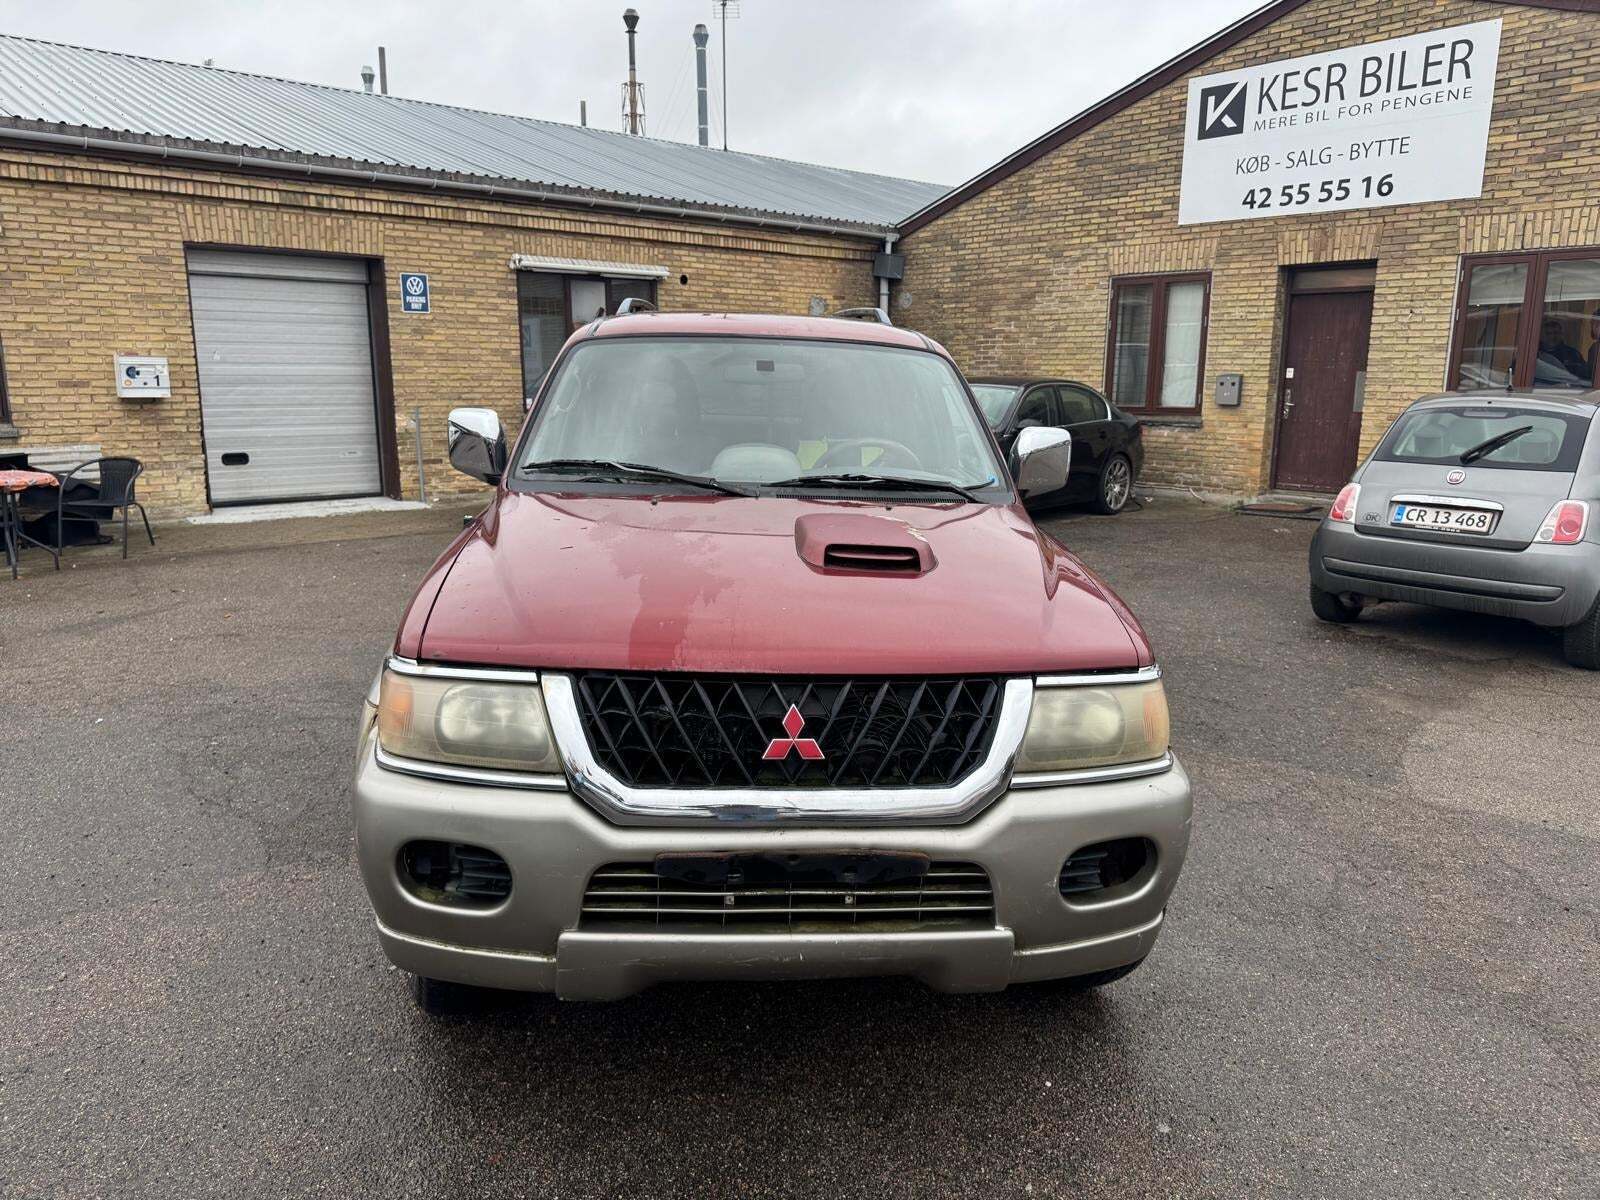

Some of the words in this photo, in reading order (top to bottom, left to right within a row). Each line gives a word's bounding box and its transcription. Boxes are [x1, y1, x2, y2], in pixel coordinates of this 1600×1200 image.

[1258, 63, 1347, 114] KESR
[1360, 39, 1473, 97] BILER
[1254, 115, 1296, 131] MERE
[1305, 110, 1329, 123] BIL
[1338, 103, 1372, 118] FOR
[1381, 87, 1472, 111] PENGENE
[1236, 155, 1269, 174] KØB
[1286, 147, 1331, 168] SALG
[1350, 136, 1410, 160] BYTTE
[1242, 187, 1271, 209] 42
[1279, 183, 1310, 206] 55
[1318, 179, 1350, 202] 55
[1362, 174, 1393, 198] 16
[153, 375, 160, 387] 1
[1406, 508, 1427, 521] CR
[1432, 510, 1451, 524] 13
[1456, 513, 1487, 528] 468
